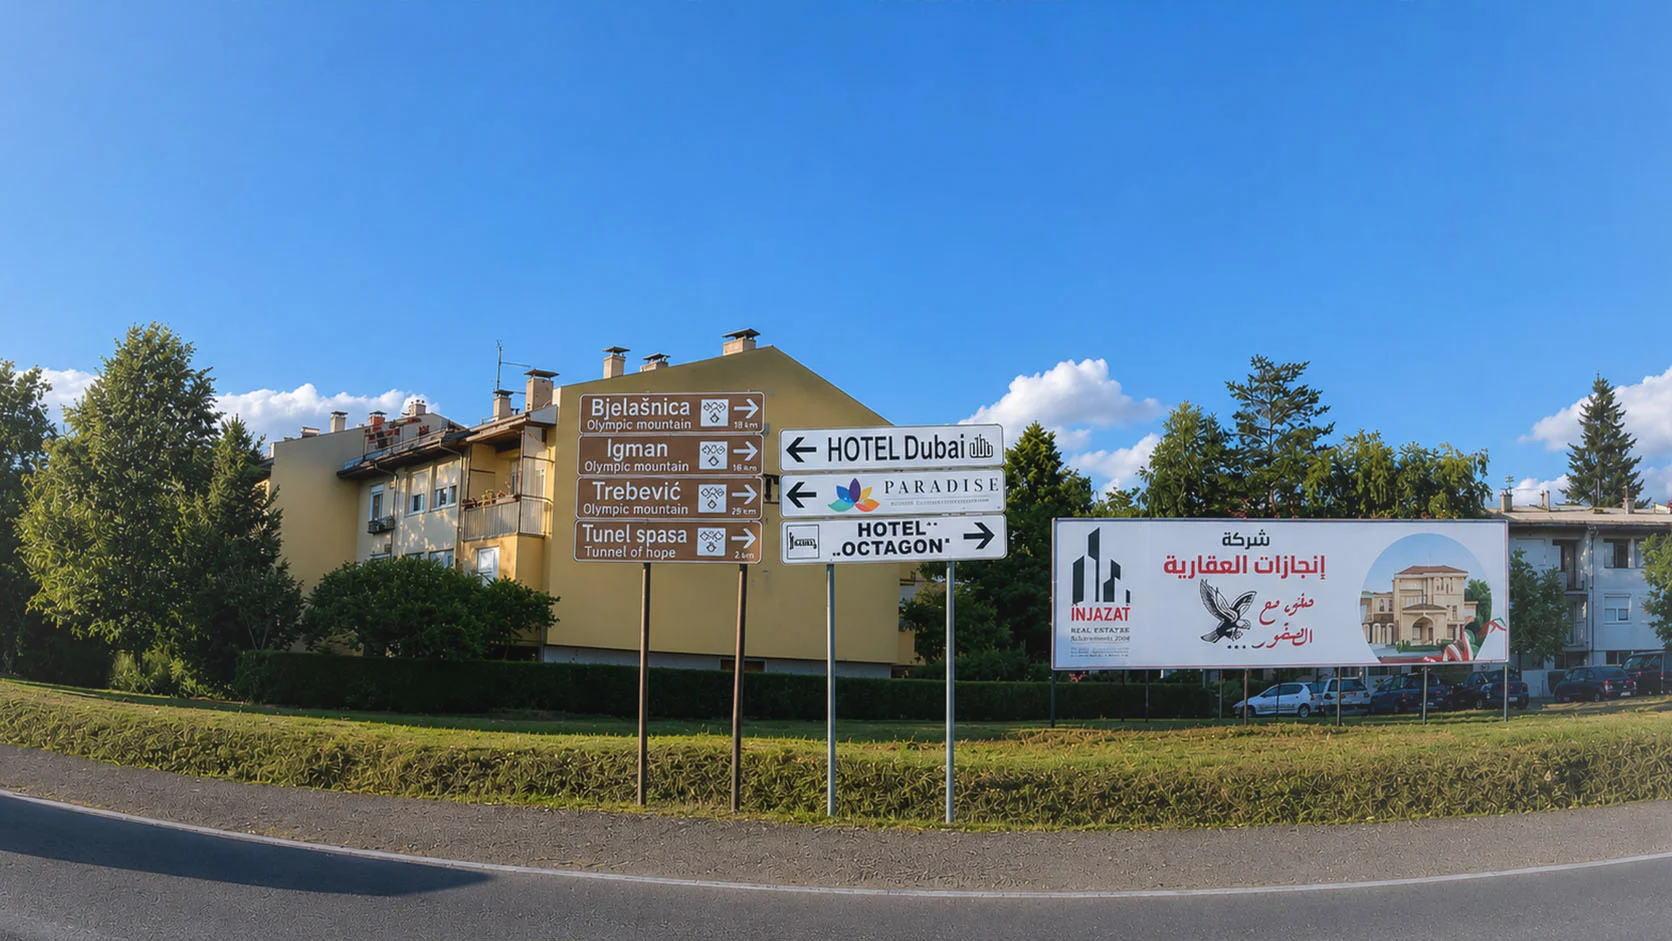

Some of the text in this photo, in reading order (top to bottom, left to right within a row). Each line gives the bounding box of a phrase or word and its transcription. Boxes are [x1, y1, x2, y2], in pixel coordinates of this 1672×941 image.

[591, 397, 691, 420] Bjelašnica
[586, 419, 692, 433] Olympic mountain
[607, 438, 668, 462] Igman
[827, 434, 965, 462] HOTEL Dubai
[584, 460, 689, 474] Olympic mountain
[592, 481, 681, 501] Trebević
[884, 477, 999, 494] PARADISE
[583, 503, 689, 517] Olympic mountain
[582, 524, 688, 549] Tunel spasa
[1222, 529, 1270, 550] شركة
[584, 545, 676, 560] Tunnel of hope
[734, 550, 741, 559] 2
[1163, 554, 1326, 580] إنجازات العقارية
[1071, 607, 1131, 621] INJAZAT
